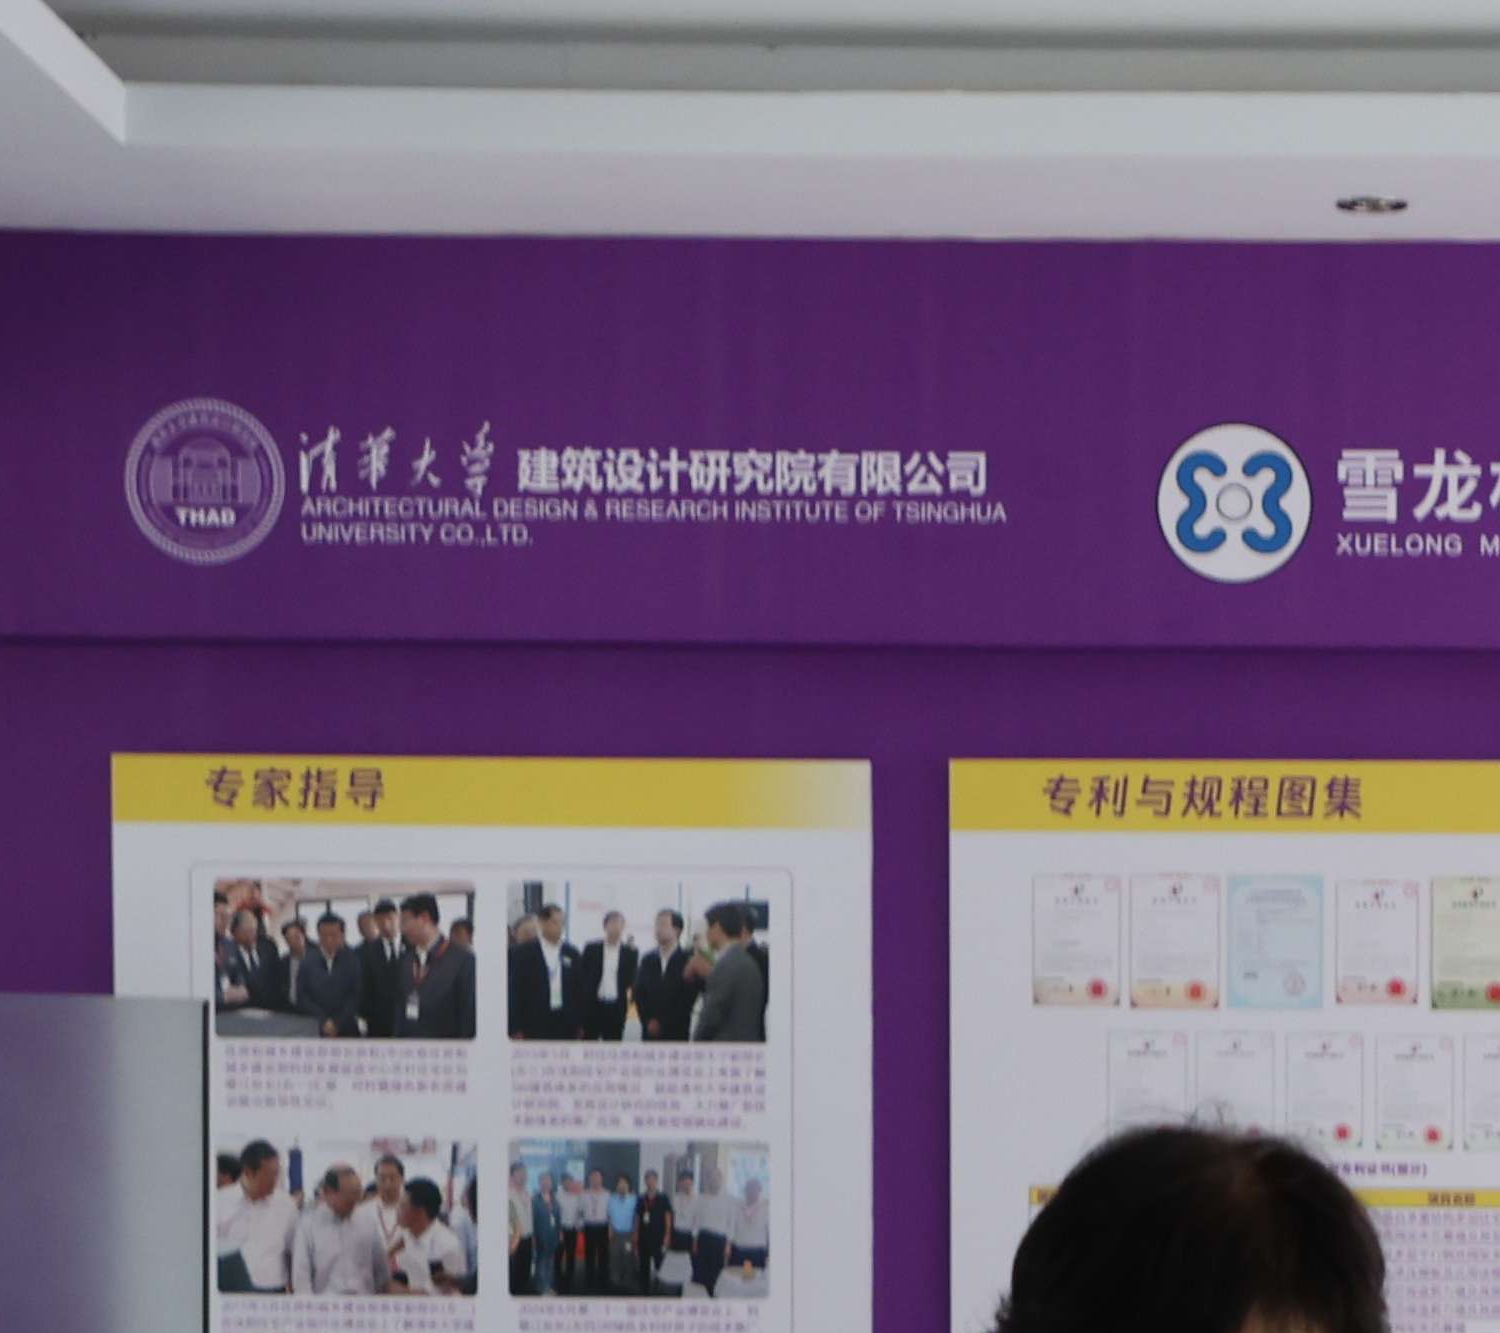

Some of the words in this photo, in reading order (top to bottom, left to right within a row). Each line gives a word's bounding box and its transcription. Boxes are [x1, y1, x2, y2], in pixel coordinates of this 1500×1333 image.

[516, 446, 988, 497] 建筑设计研究院有限公司
[301, 498, 486, 523] ARCHITECTURAL
[493, 498, 578, 523] DESIGN
[584, 499, 598, 521] &
[605, 498, 728, 524] RESEARCH
[735, 498, 848, 523] INSTITUTE
[855, 500, 886, 523] OF
[894, 500, 1007, 524] TSINGHUA
[301, 523, 433, 546] UNIVERSITY
[1336, 533, 1464, 556] XUELONG
[204, 766, 385, 811] 专家指导
[1041, 774, 1364, 820] 专利与规程图集
